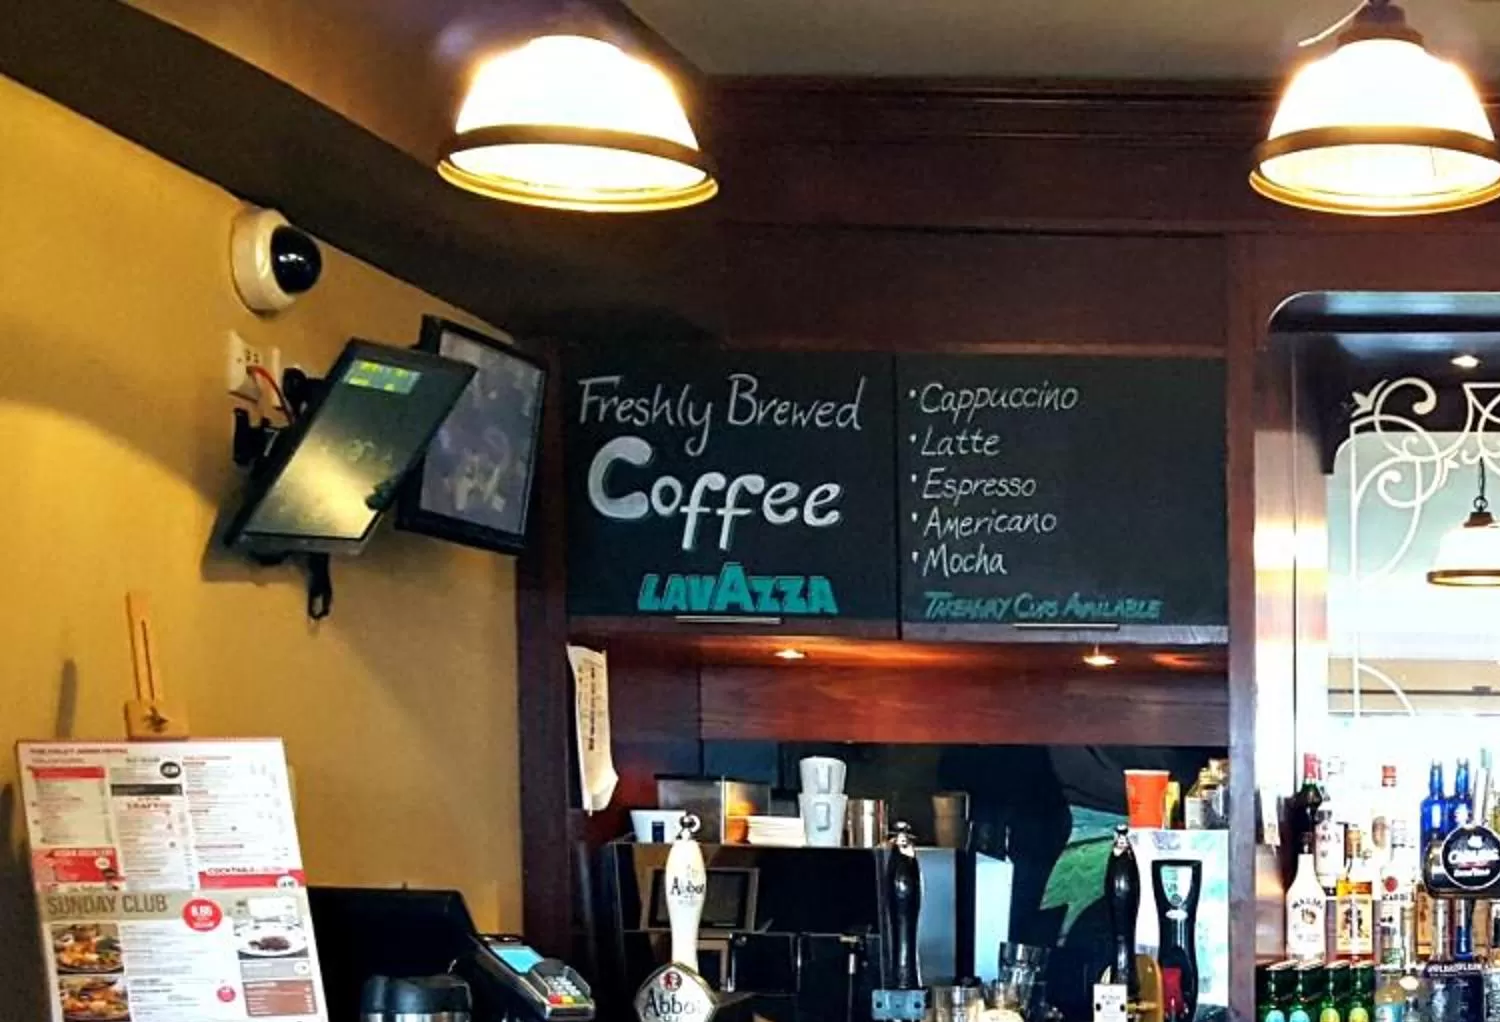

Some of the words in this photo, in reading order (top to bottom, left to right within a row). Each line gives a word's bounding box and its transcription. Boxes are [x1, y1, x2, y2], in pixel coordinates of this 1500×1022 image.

[577, 374, 714, 457] Freshly
[727, 372, 868, 431] Brewed
[919, 380, 1079, 424] Cappuccino
[920, 424, 1001, 457] Latte
[587, 435, 842, 550] Coffee
[922, 466, 1037, 506] Espresso
[923, 506, 1057, 540] Americano
[922, 543, 1007, 579] Mocha
[637, 561, 839, 615] LAVAZZA
[47, 894, 117, 917] SUNDAY
[122, 892, 168, 912] CLUB
[643, 989, 703, 1018] Abbo
